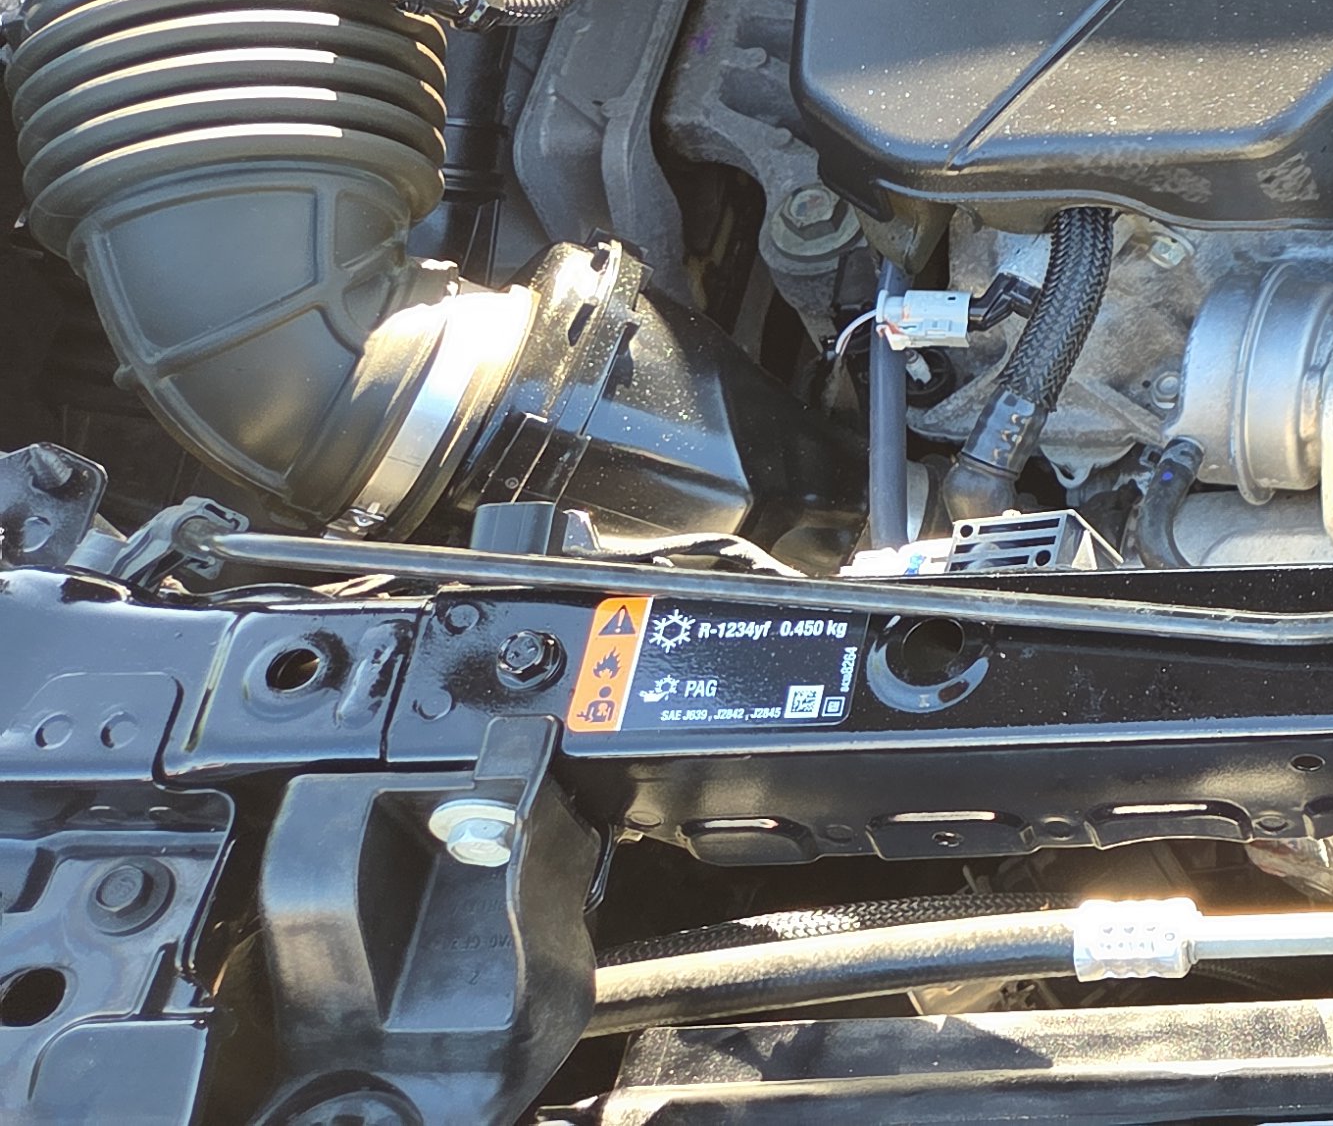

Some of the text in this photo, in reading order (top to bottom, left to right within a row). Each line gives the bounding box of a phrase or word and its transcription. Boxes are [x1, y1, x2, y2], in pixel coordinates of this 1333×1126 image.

[697, 620, 847, 640] R-1234yf 0.450 kg
[684, 680, 718, 698] PAG
[660, 709, 682, 721] SAE
